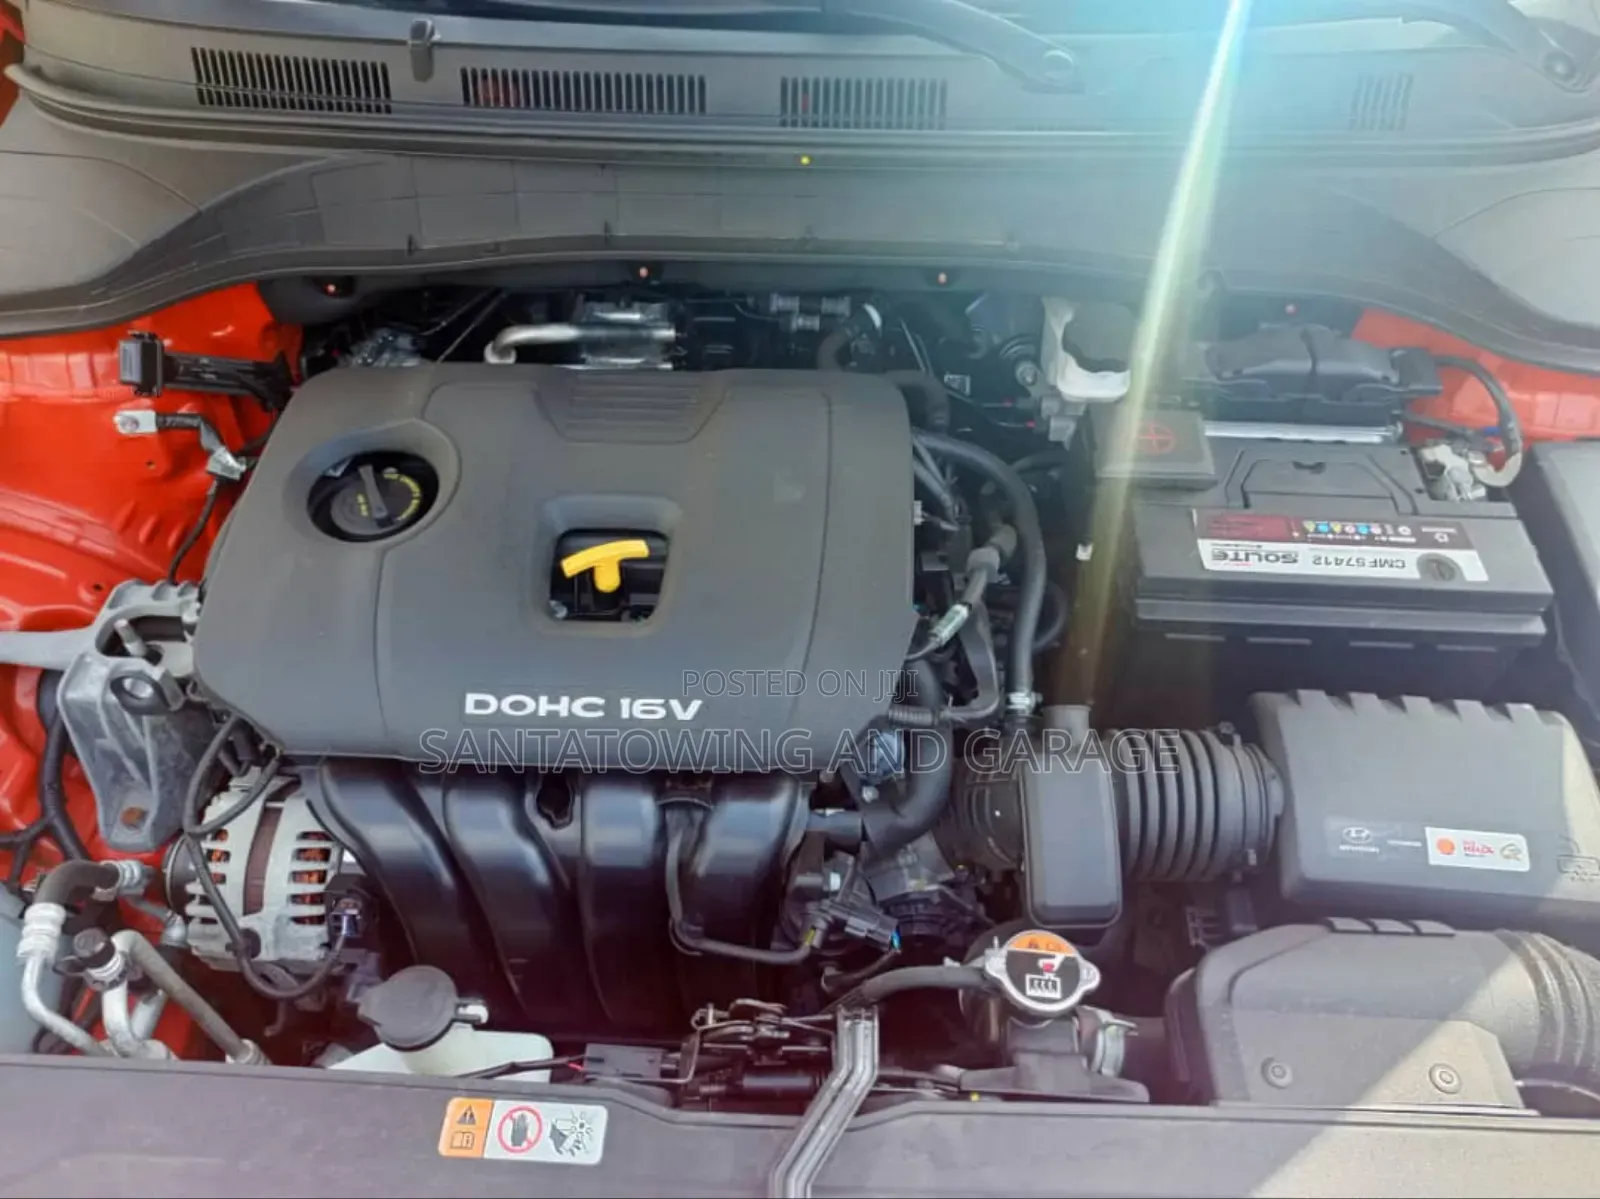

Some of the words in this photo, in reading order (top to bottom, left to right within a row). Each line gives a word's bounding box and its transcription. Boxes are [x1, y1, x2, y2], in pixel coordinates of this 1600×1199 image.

[1211, 549, 1299, 565] SOLITE
[464, 692, 606, 718] DOHC
[619, 697, 703, 721] 16V
